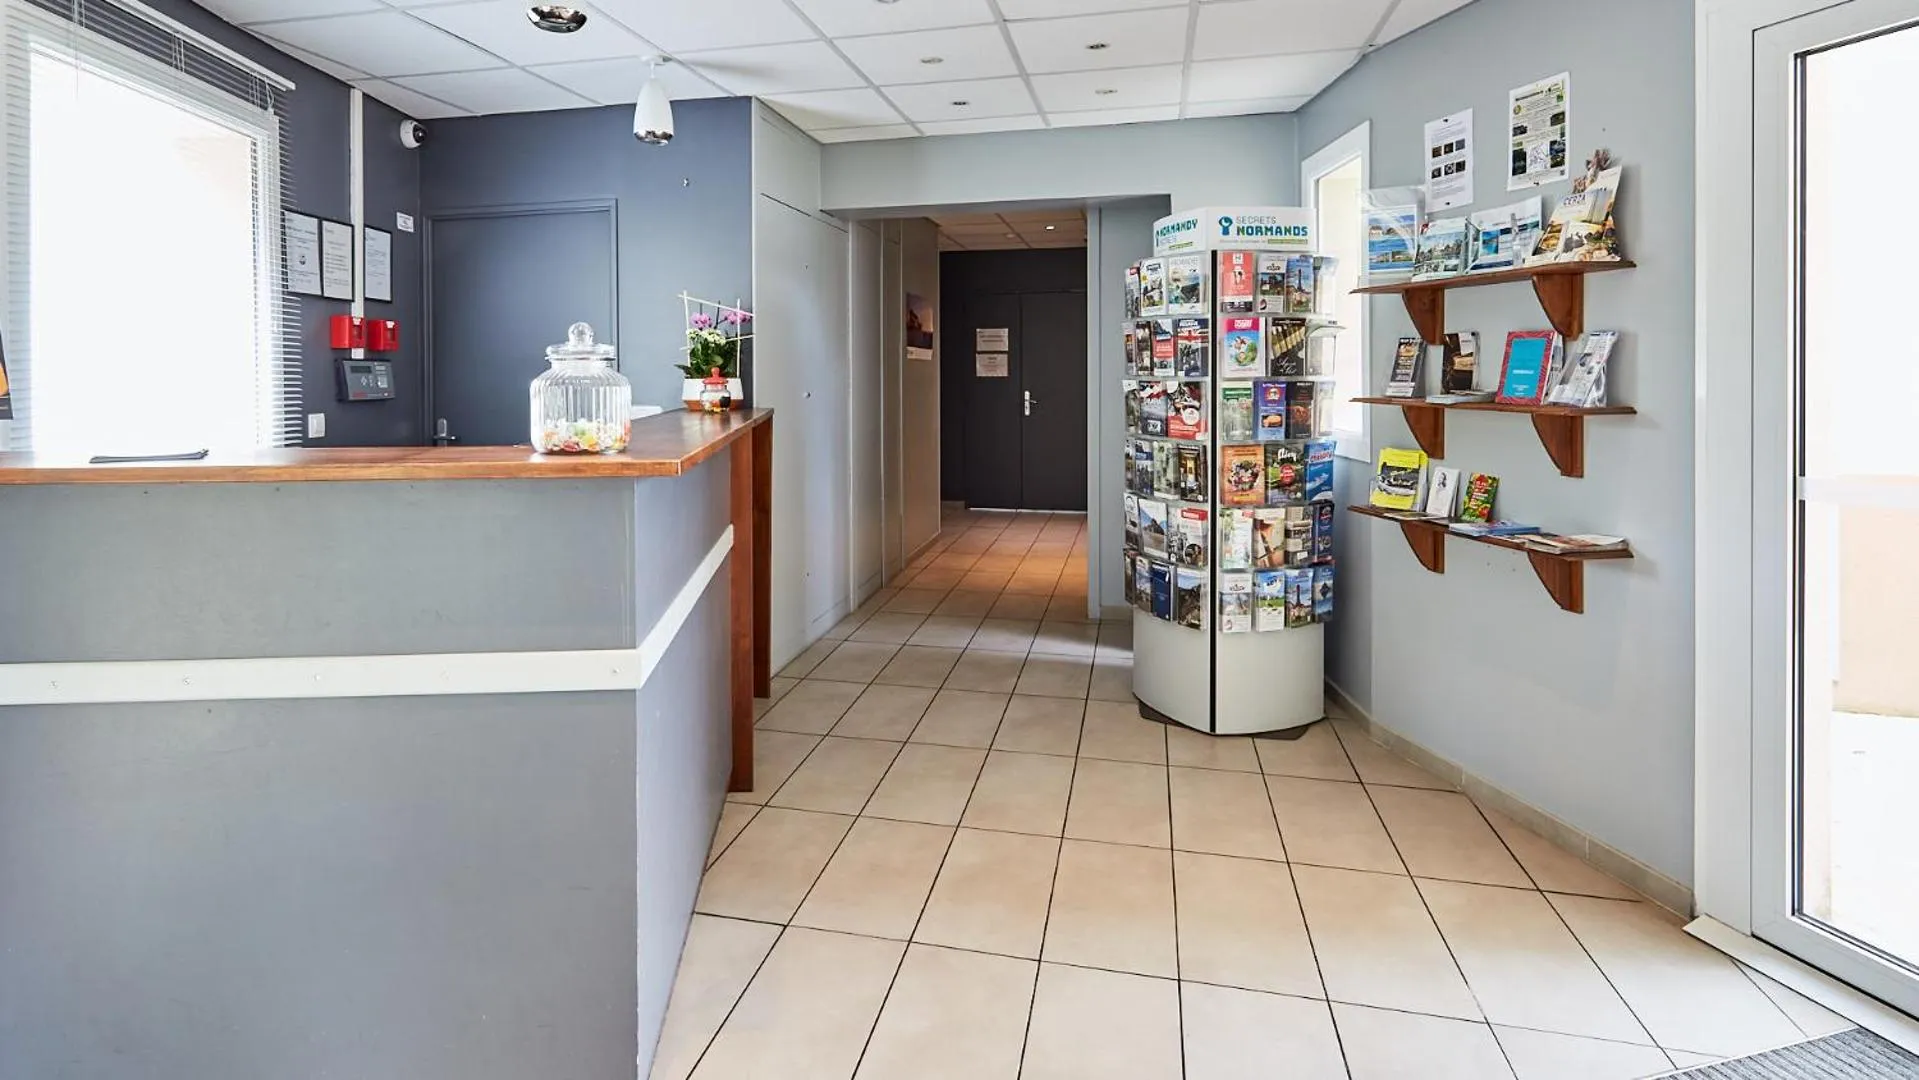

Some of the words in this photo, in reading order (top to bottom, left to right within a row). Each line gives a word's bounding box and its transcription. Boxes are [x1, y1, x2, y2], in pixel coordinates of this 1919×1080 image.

[1236, 216, 1276, 225] SECRETS
[1159, 218, 1198, 237] NORMANDY
[1236, 226, 1308, 237] NORMANDS
